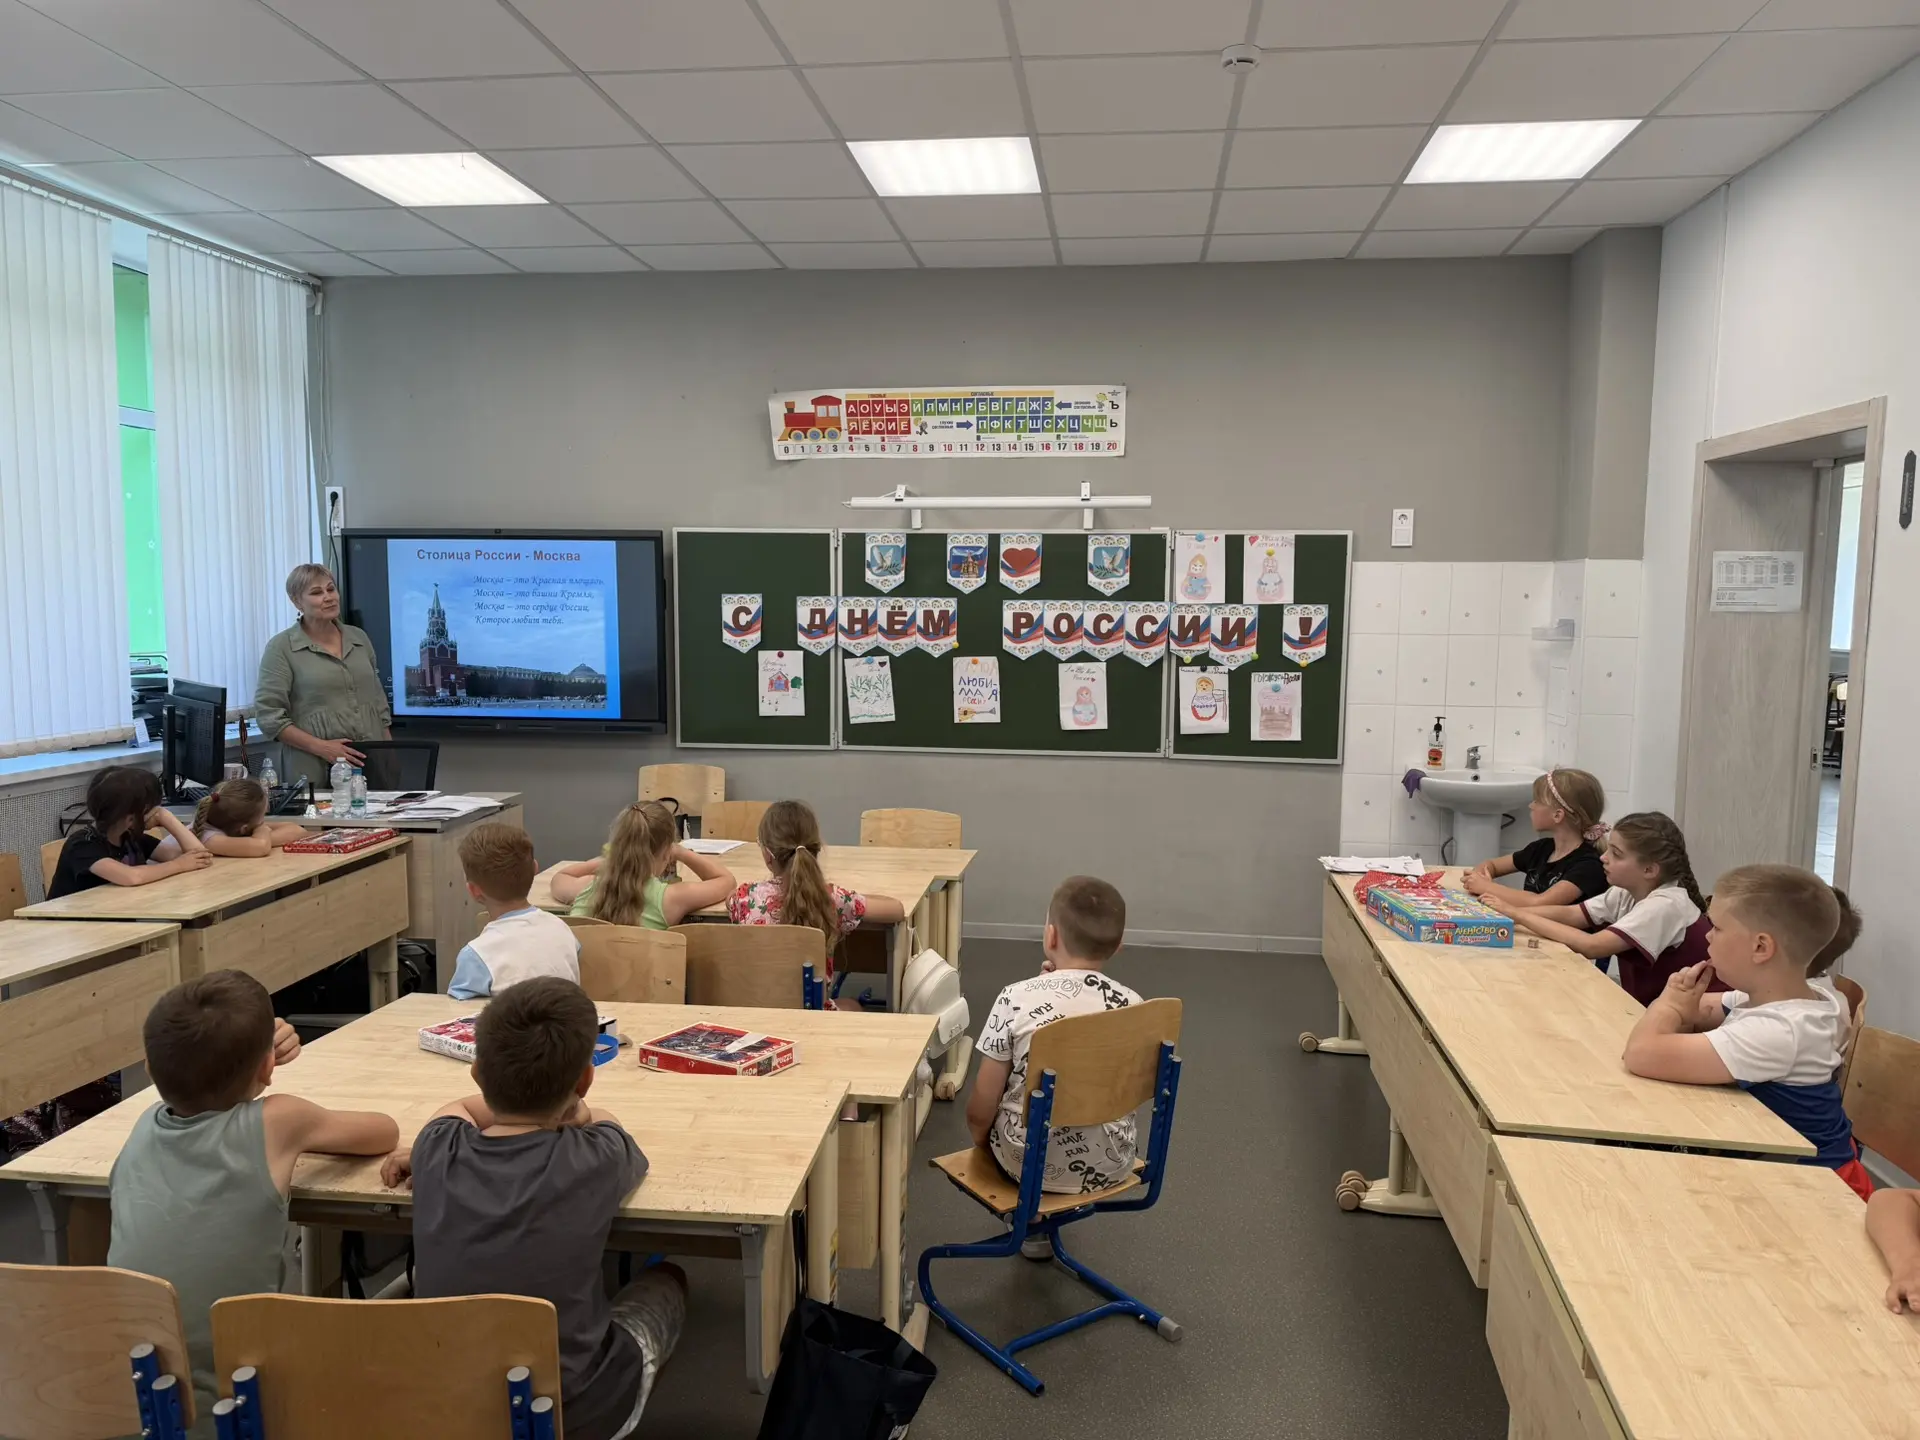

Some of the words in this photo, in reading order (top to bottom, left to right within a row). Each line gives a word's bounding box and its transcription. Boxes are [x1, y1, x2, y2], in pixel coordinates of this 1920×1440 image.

[784, 446, 789, 454] 0
[943, 443, 952, 451] 10
[960, 443, 968, 451] 11
[976, 443, 985, 451] 12
[417, 550, 470, 562] Столица
[476, 550, 521, 561] России
[534, 551, 581, 562] Москва
[474, 575, 504, 585] Москва
[474, 588, 504, 598] Москва
[475, 602, 505, 612] Москва
[475, 615, 511, 625] Которое
[732, 606, 752, 632] С
[807, 605, 950, 636] ДНЁМ
[1013, 612, 1246, 646] РОССИИ
[1057, 1131, 1087, 1146] HAVE
[1065, 1144, 1090, 1158] FUN
